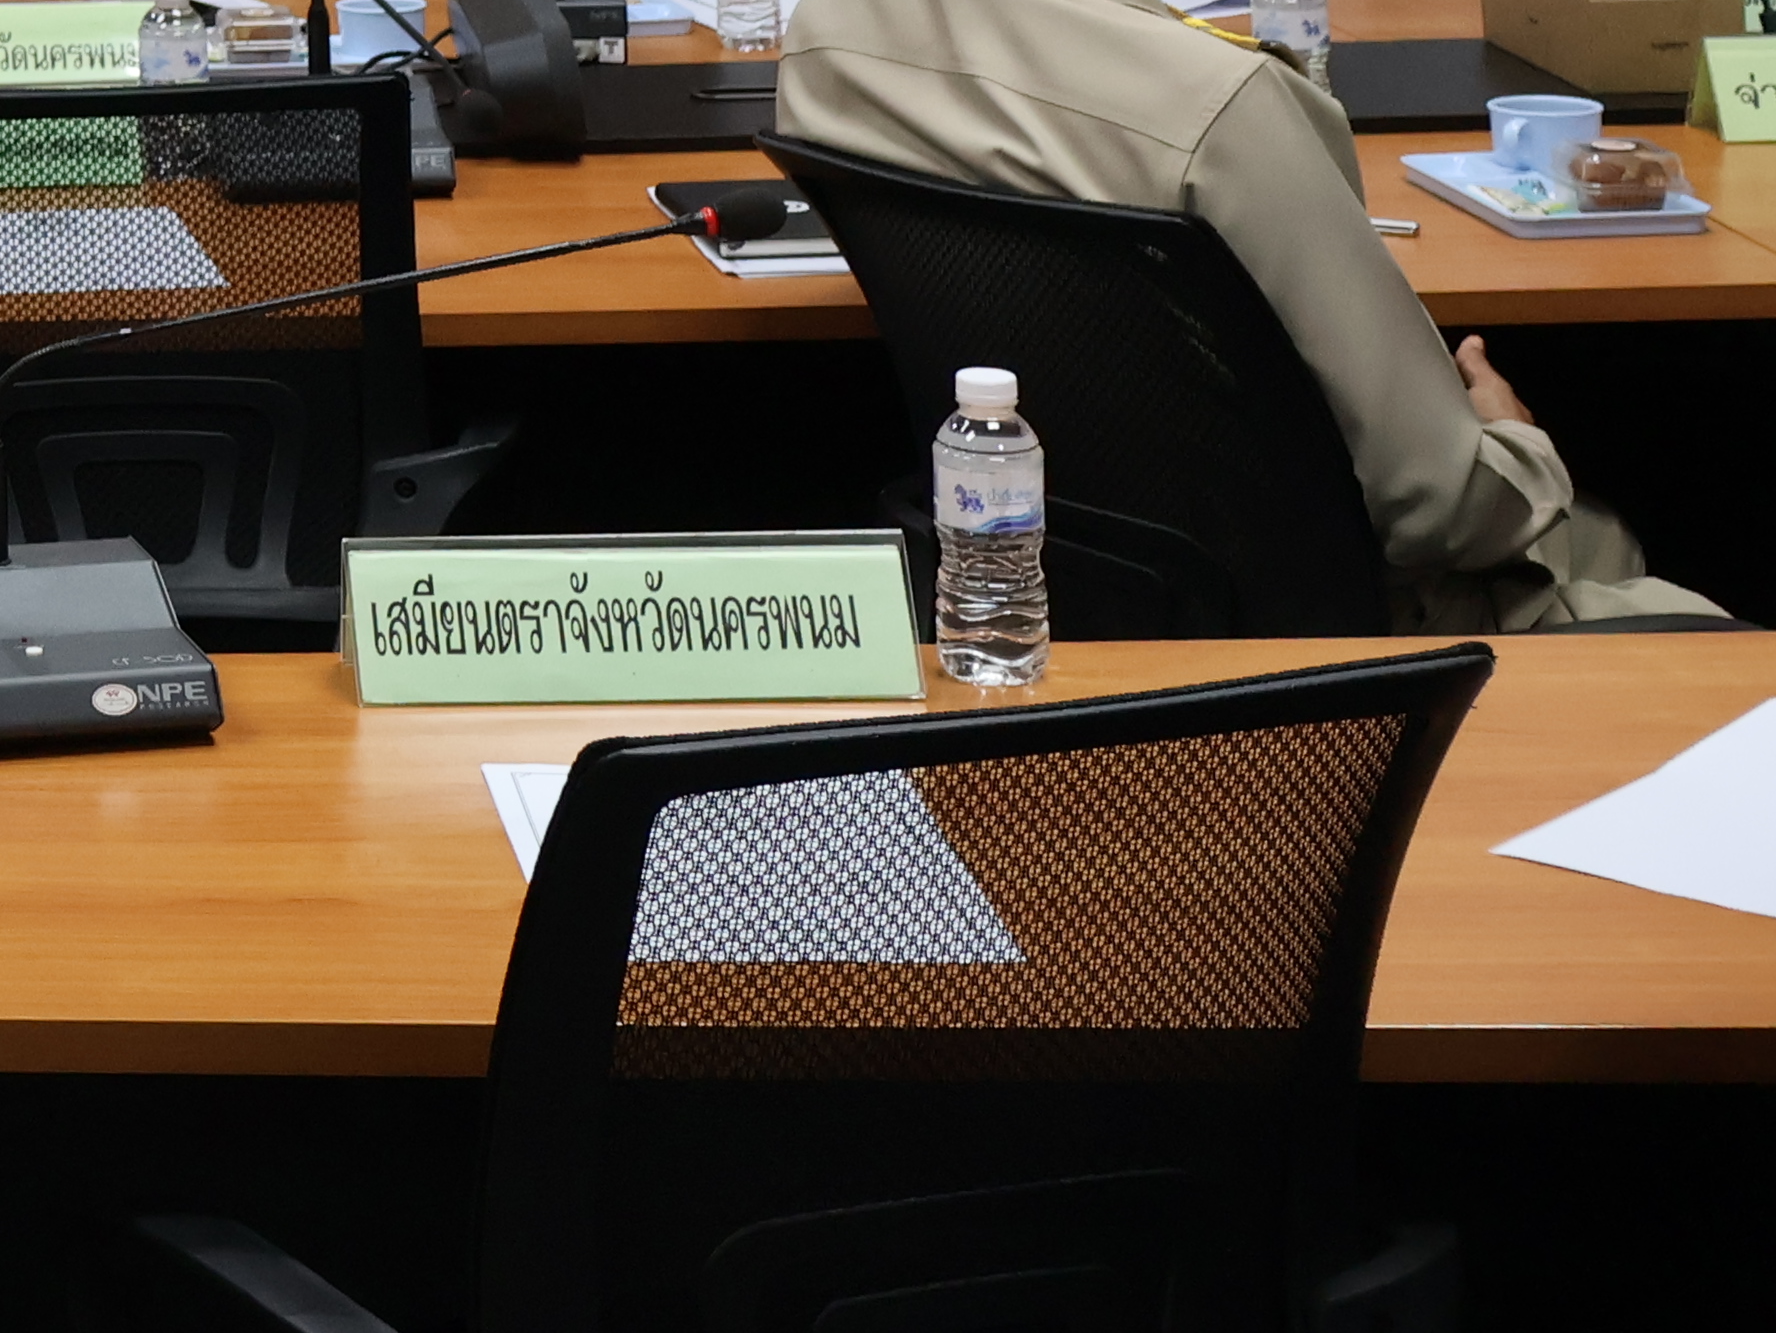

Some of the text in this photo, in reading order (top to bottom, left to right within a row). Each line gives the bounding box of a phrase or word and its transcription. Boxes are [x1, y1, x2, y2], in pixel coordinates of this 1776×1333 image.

[414, 154, 446, 169] PE
[370, 570, 862, 656] เสมียนตราจังหวัดนครพนม
[137, 680, 208, 703] NPE
